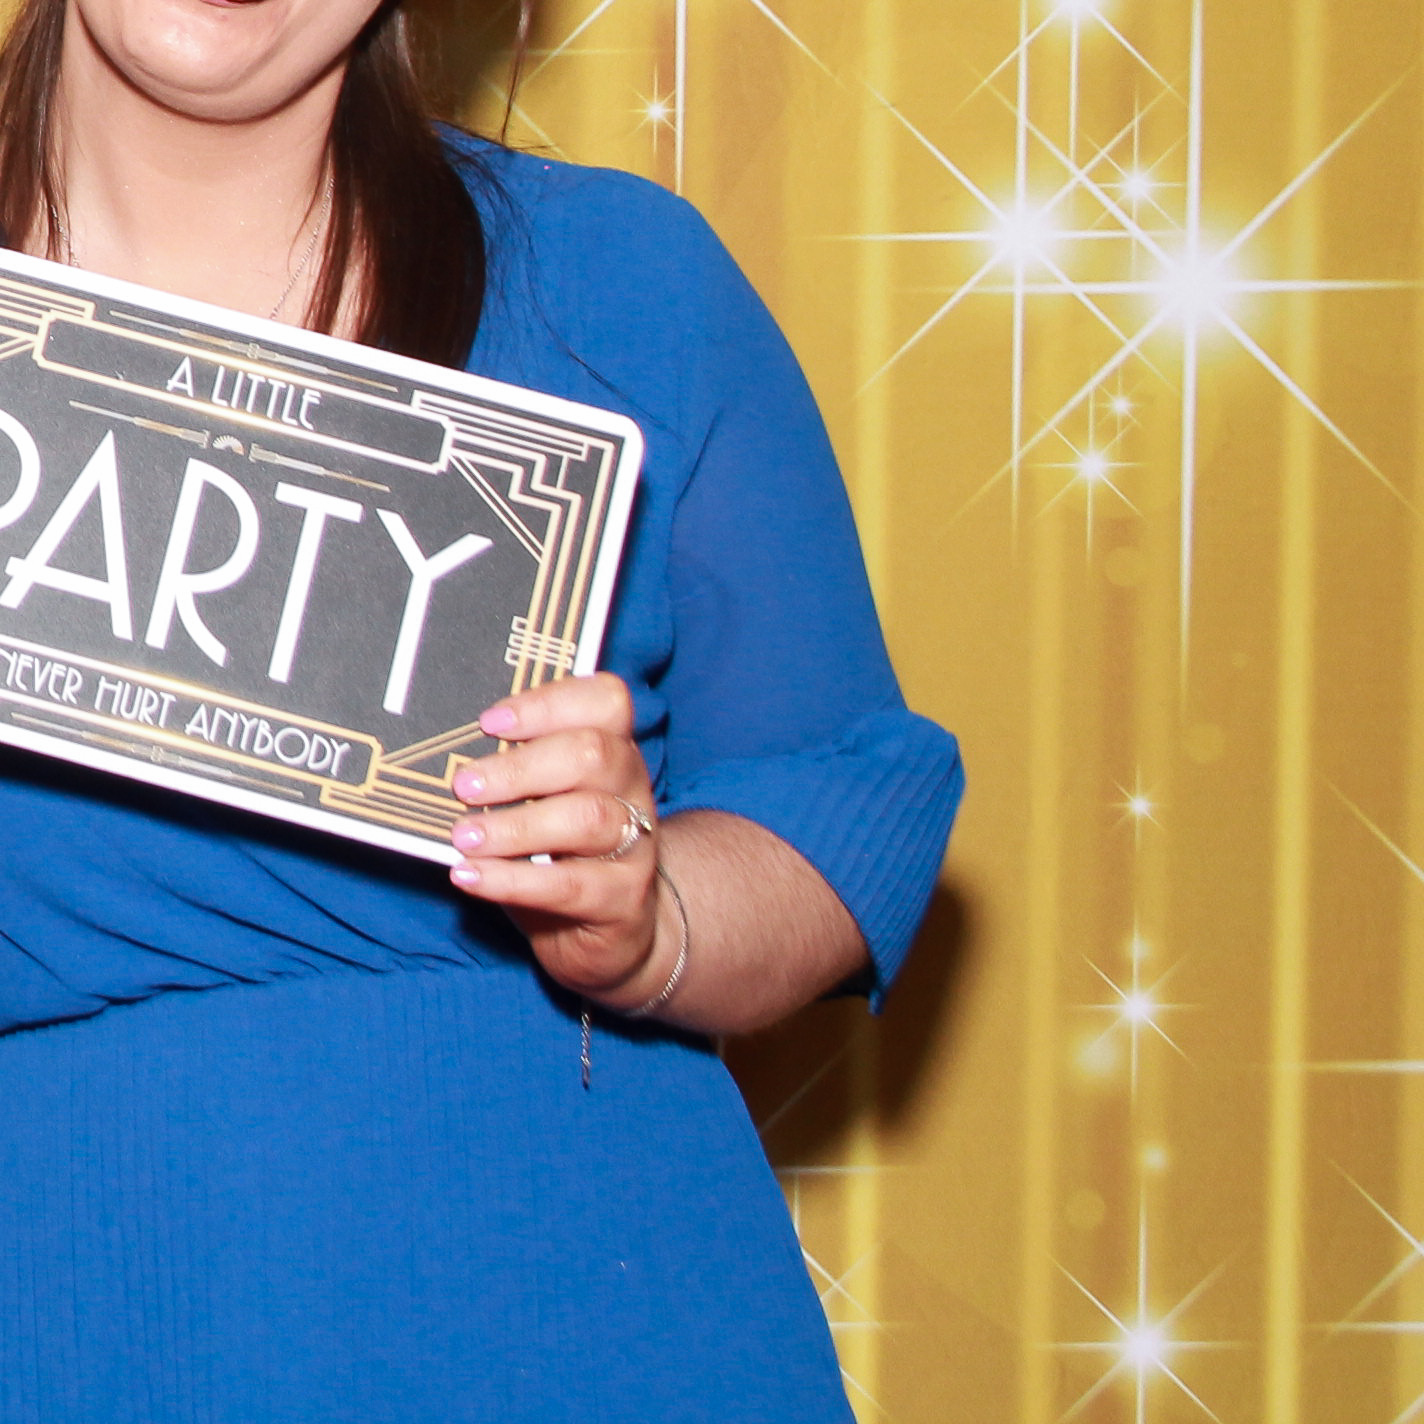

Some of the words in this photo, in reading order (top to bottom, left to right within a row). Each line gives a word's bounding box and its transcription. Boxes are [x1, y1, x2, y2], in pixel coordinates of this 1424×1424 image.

[166, 356, 196, 399] A
[211, 365, 323, 429] LITTLE
[94, 675, 177, 728] HURT
[185, 702, 350, 776] ANYBODY
